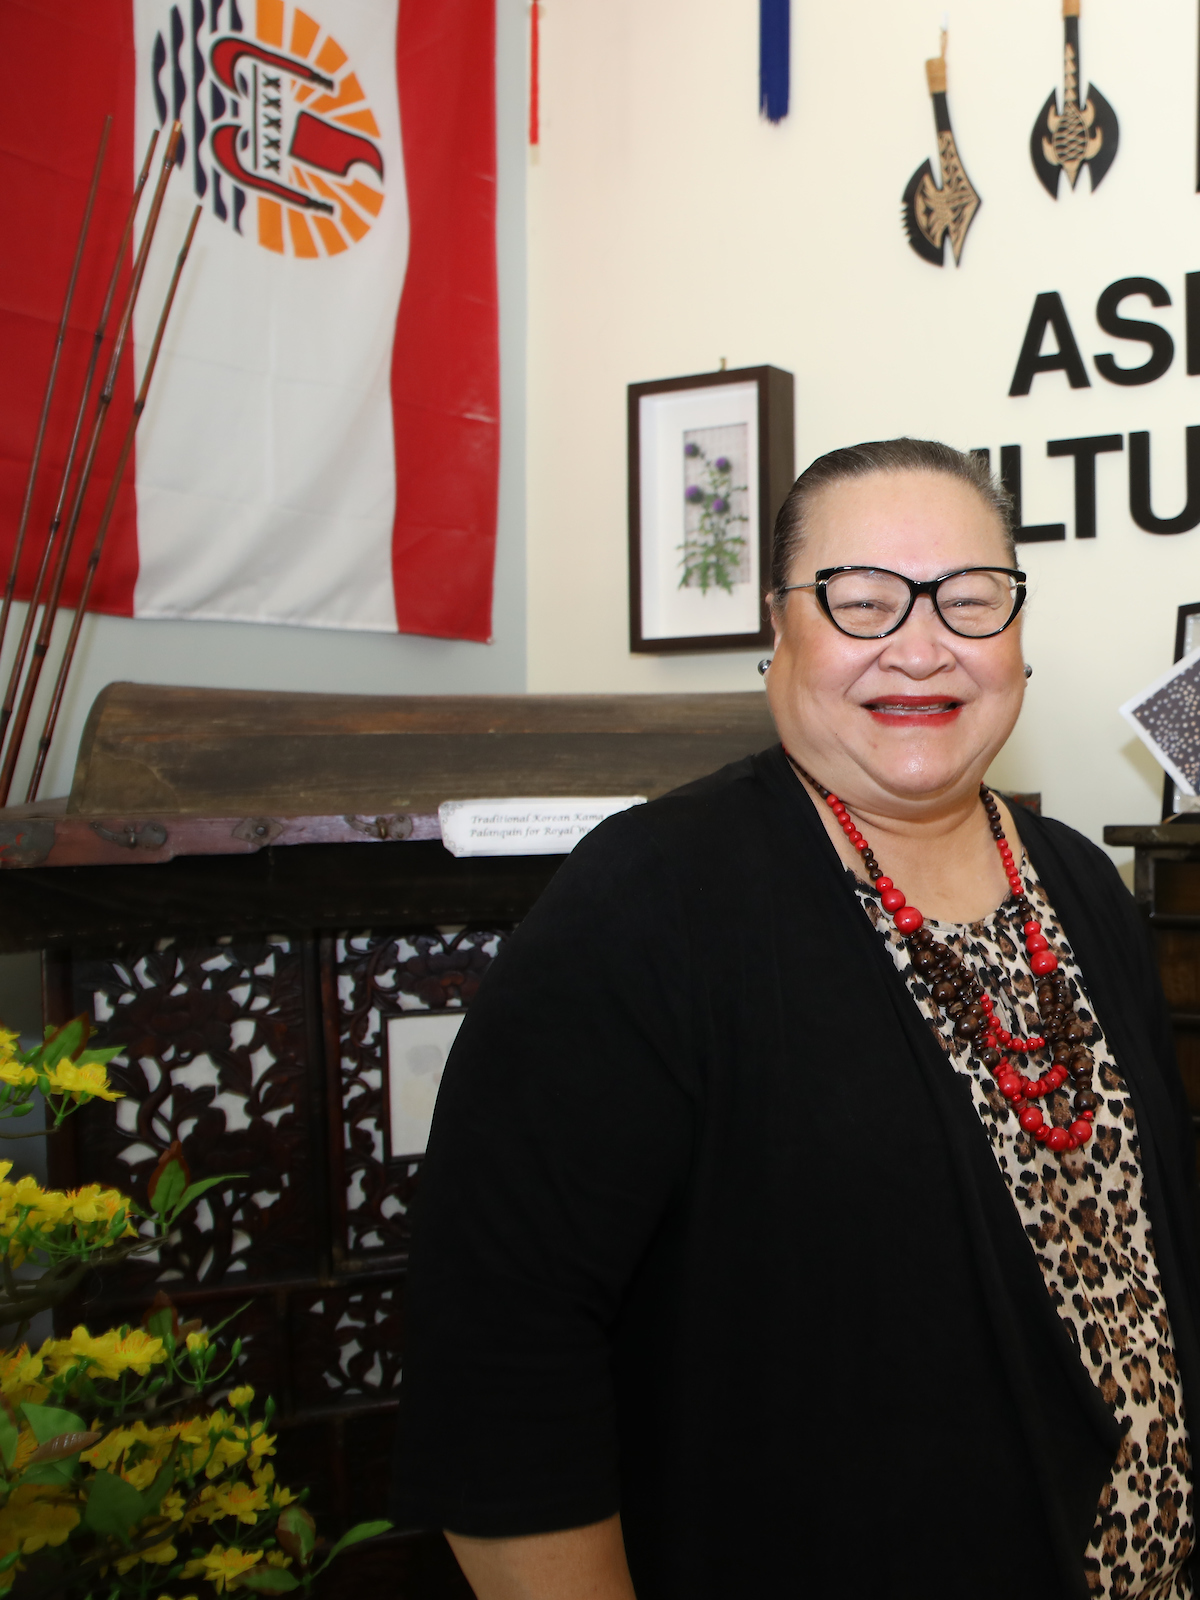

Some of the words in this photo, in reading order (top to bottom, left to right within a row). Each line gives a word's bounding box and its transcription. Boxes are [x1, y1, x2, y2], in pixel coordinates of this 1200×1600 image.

[471, 813, 530, 825] Traditional
[532, 813, 571, 823] Korean
[470, 827, 523, 839] Palanquin
[525, 827, 540, 838] for
[543, 825, 574, 837] Royal
